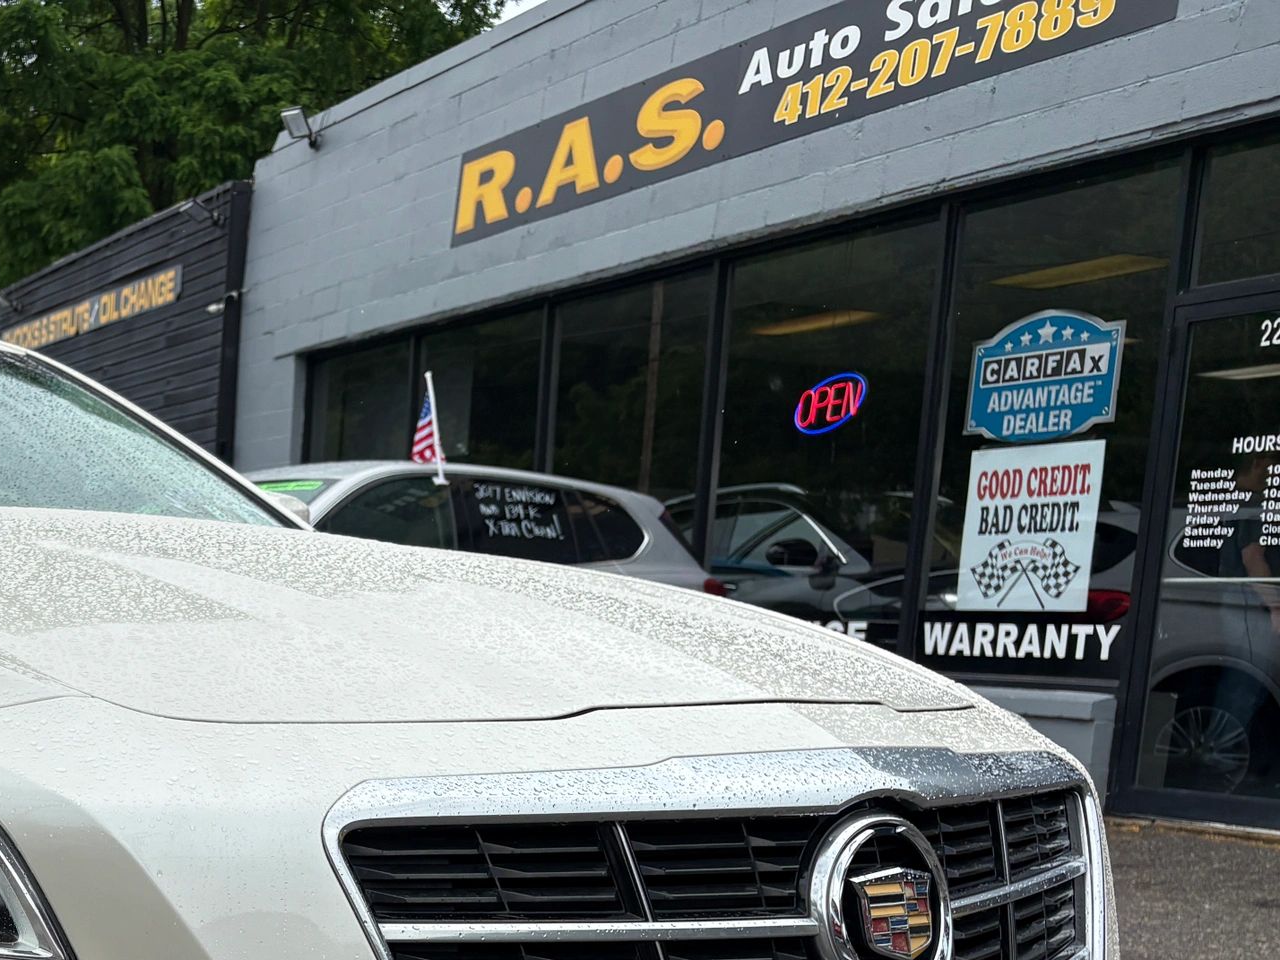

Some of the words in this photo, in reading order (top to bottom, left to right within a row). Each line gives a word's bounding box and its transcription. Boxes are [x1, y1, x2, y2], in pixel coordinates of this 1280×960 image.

[738, 24, 861, 95] Auto
[884, 0, 1001, 41] Sa
[773, 0, 1117, 126] 412-207-7889
[455, 77, 726, 236] R.A.S.
[99, 294, 120, 323] OIL
[121, 271, 176, 317] CHANGE
[1260, 316, 1280, 346] 22
[985, 351, 1104, 383] CARFAX
[797, 381, 862, 427] OPEN
[987, 381, 1094, 413] ADVANTAGE
[1002, 409, 1072, 436] DEALER
[977, 468, 1023, 501] GOOD
[1027, 463, 1091, 498] CREDIT.
[1190, 480, 1236, 491] Tuesday
[1191, 468, 1235, 479] Monday
[1187, 503, 1239, 514] Thursday
[1188, 490, 1252, 502] Wednesday
[978, 504, 1013, 536] BAD
[1017, 501, 1080, 534] CREDIT.
[1184, 526, 1234, 537] Saturday
[1186, 514, 1220, 526] Friday
[1183, 538, 1223, 549] Sunday
[923, 621, 1121, 661] WARRANTY
